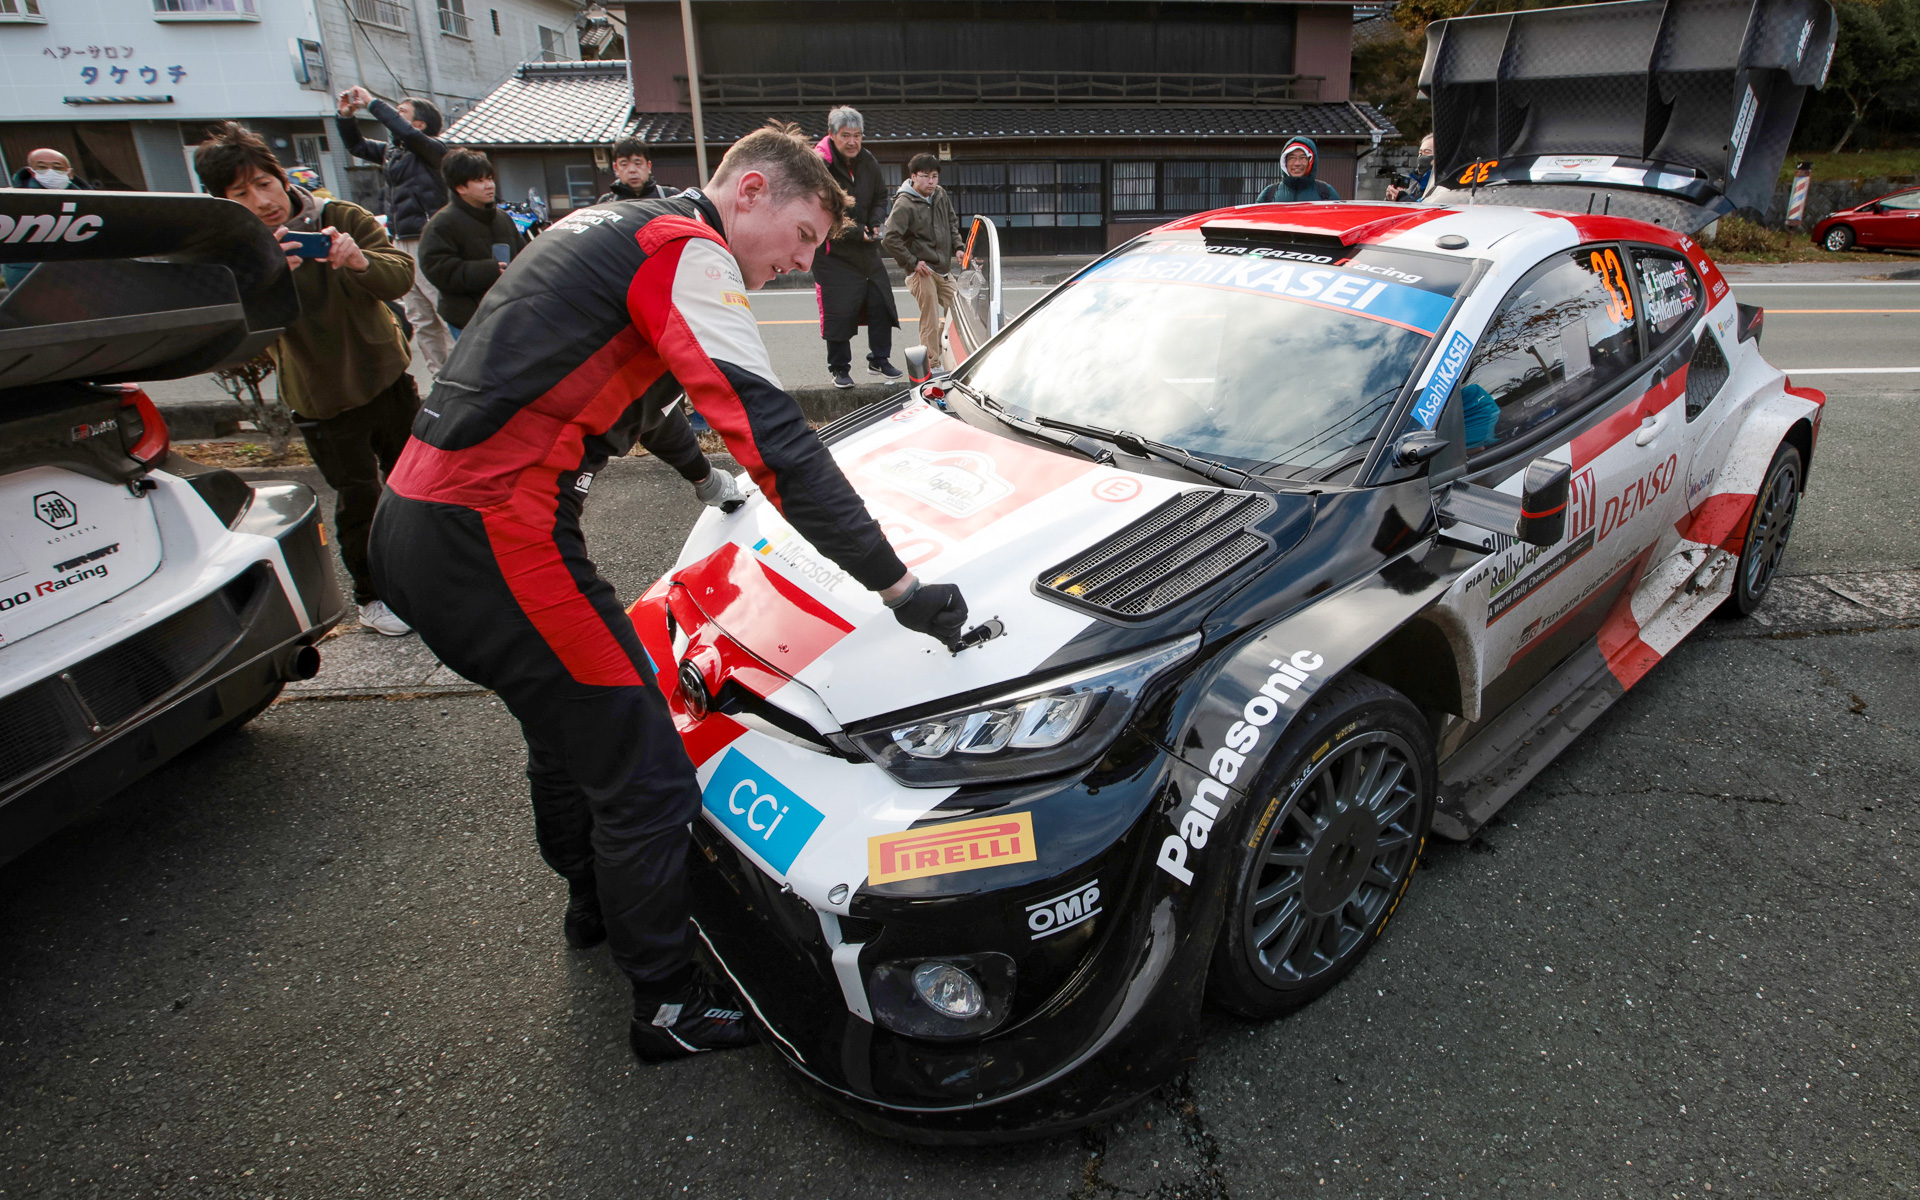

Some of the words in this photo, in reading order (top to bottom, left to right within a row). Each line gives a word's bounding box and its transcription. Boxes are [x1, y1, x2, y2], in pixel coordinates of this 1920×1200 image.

[42, 45, 135, 59] ヘアーサロン
[80, 64, 188, 85] タケウチ
[1735, 92, 1750, 139] KINTO
[1113, 256, 1389, 310] AsahiKASEI
[1173, 244, 1248, 255] TOYOTA
[1248, 248, 1333, 264] GAZOO
[1334, 257, 1423, 284] Racing
[1590, 248, 1634, 324] 33
[1418, 334, 1470, 426] AsahiKASEI
[40, 498, 73, 523] 湖
[1597, 453, 1677, 543] DENSO
[46, 525, 98, 545] KOIKEYA
[34, 564, 109, 597] Racing
[775, 541, 844, 592] Microsoft
[1465, 567, 1490, 593] PIAA
[1494, 595, 1512, 611] World
[1513, 583, 1528, 601] Rally
[1529, 555, 1567, 587] Championship
[1541, 594, 1581, 629] TOYOTA
[1156, 650, 1324, 887] Panasonic
[728, 779, 789, 841] CCi
[880, 821, 1021, 875] PIRELLI
[1027, 886, 1101, 933] OMP
[704, 1008, 744, 1020] one
